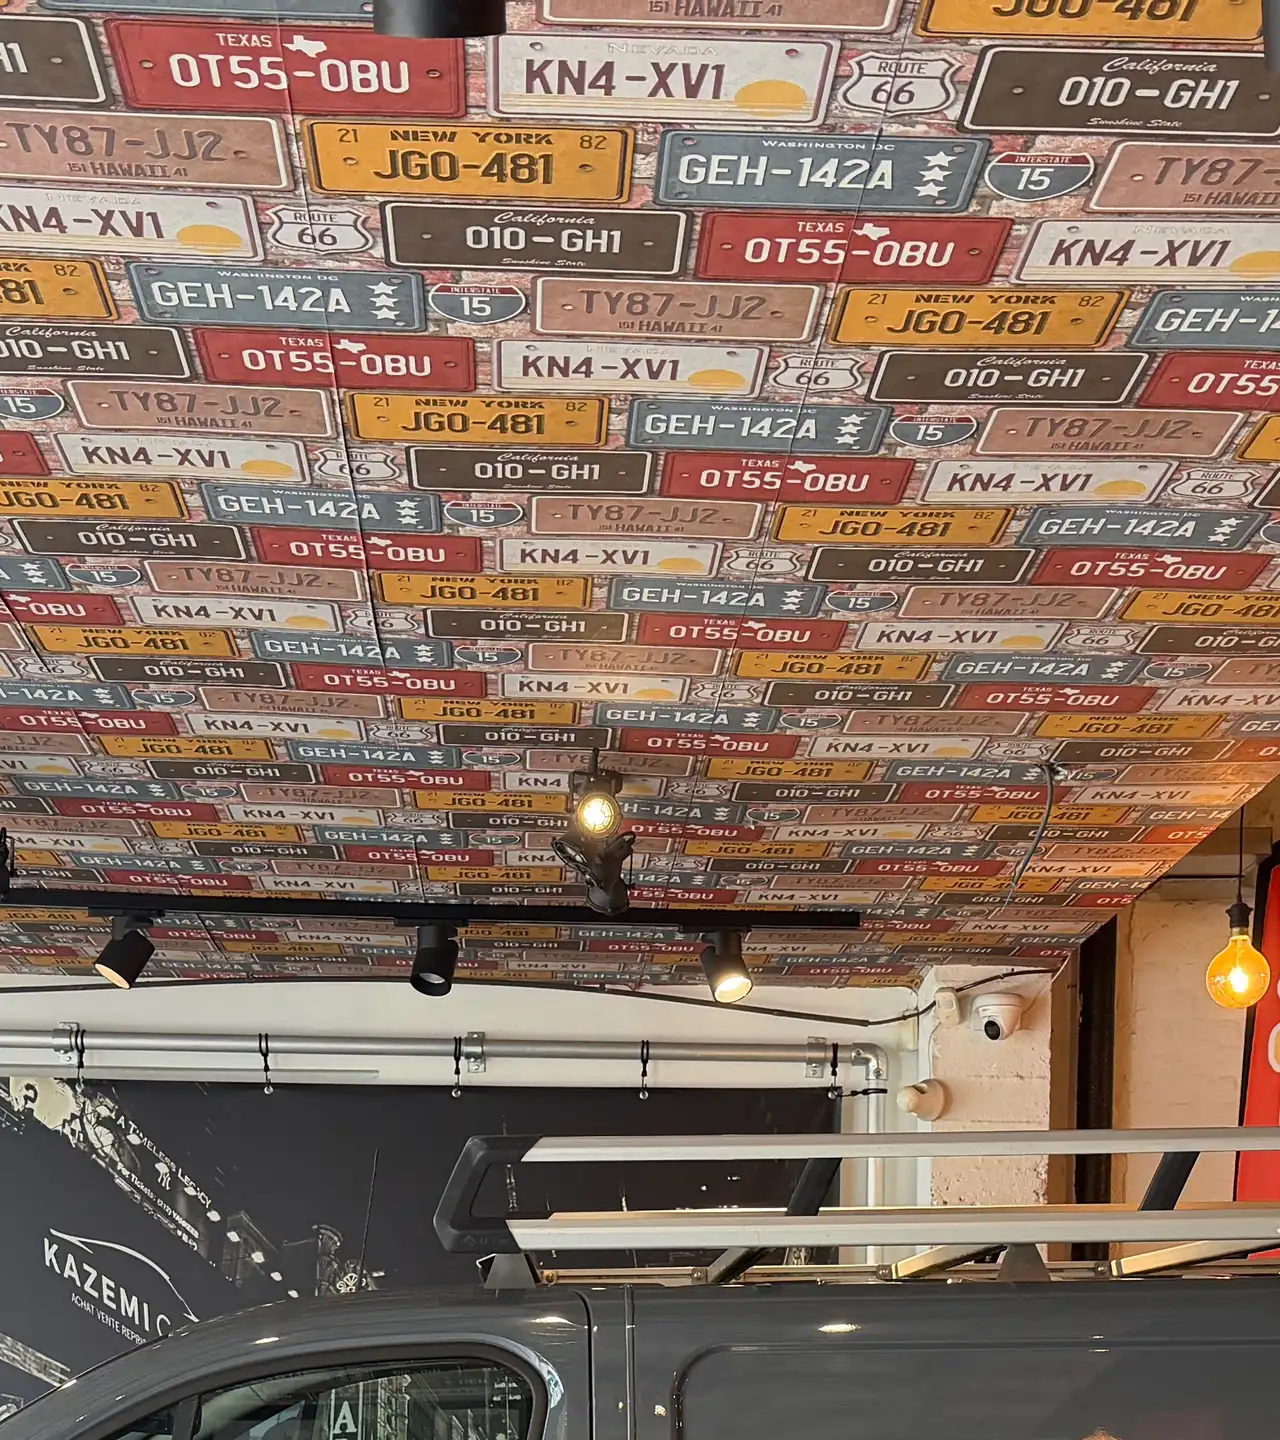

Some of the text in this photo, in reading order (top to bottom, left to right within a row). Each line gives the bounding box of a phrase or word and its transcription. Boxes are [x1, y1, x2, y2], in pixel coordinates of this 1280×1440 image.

[215, 32, 275, 49] TEXAS
[524, 54, 727, 104] KN4-XV1
[874, 60, 929, 76] ROUTE
[1100, 55, 1222, 77] California
[867, 78, 920, 105] 66
[336, 127, 608, 151] 21 NEW YORK 82
[676, 152, 901, 191] GEH-142A
[1011, 166, 1057, 192] 15
[493, 210, 596, 228] California
[294, 225, 338, 246] 66
[1046, 235, 1233, 270] KN4-XV1
[147, 279, 353, 314] GEH-142A
[458, 295, 492, 318] 15
[520, 352, 681, 384] KN4-XV1
[215, 493, 382, 520] GEH-142A
[43, 1237, 150, 1332] KAZEMI
[71, 1292, 96, 1316] ACHAT
